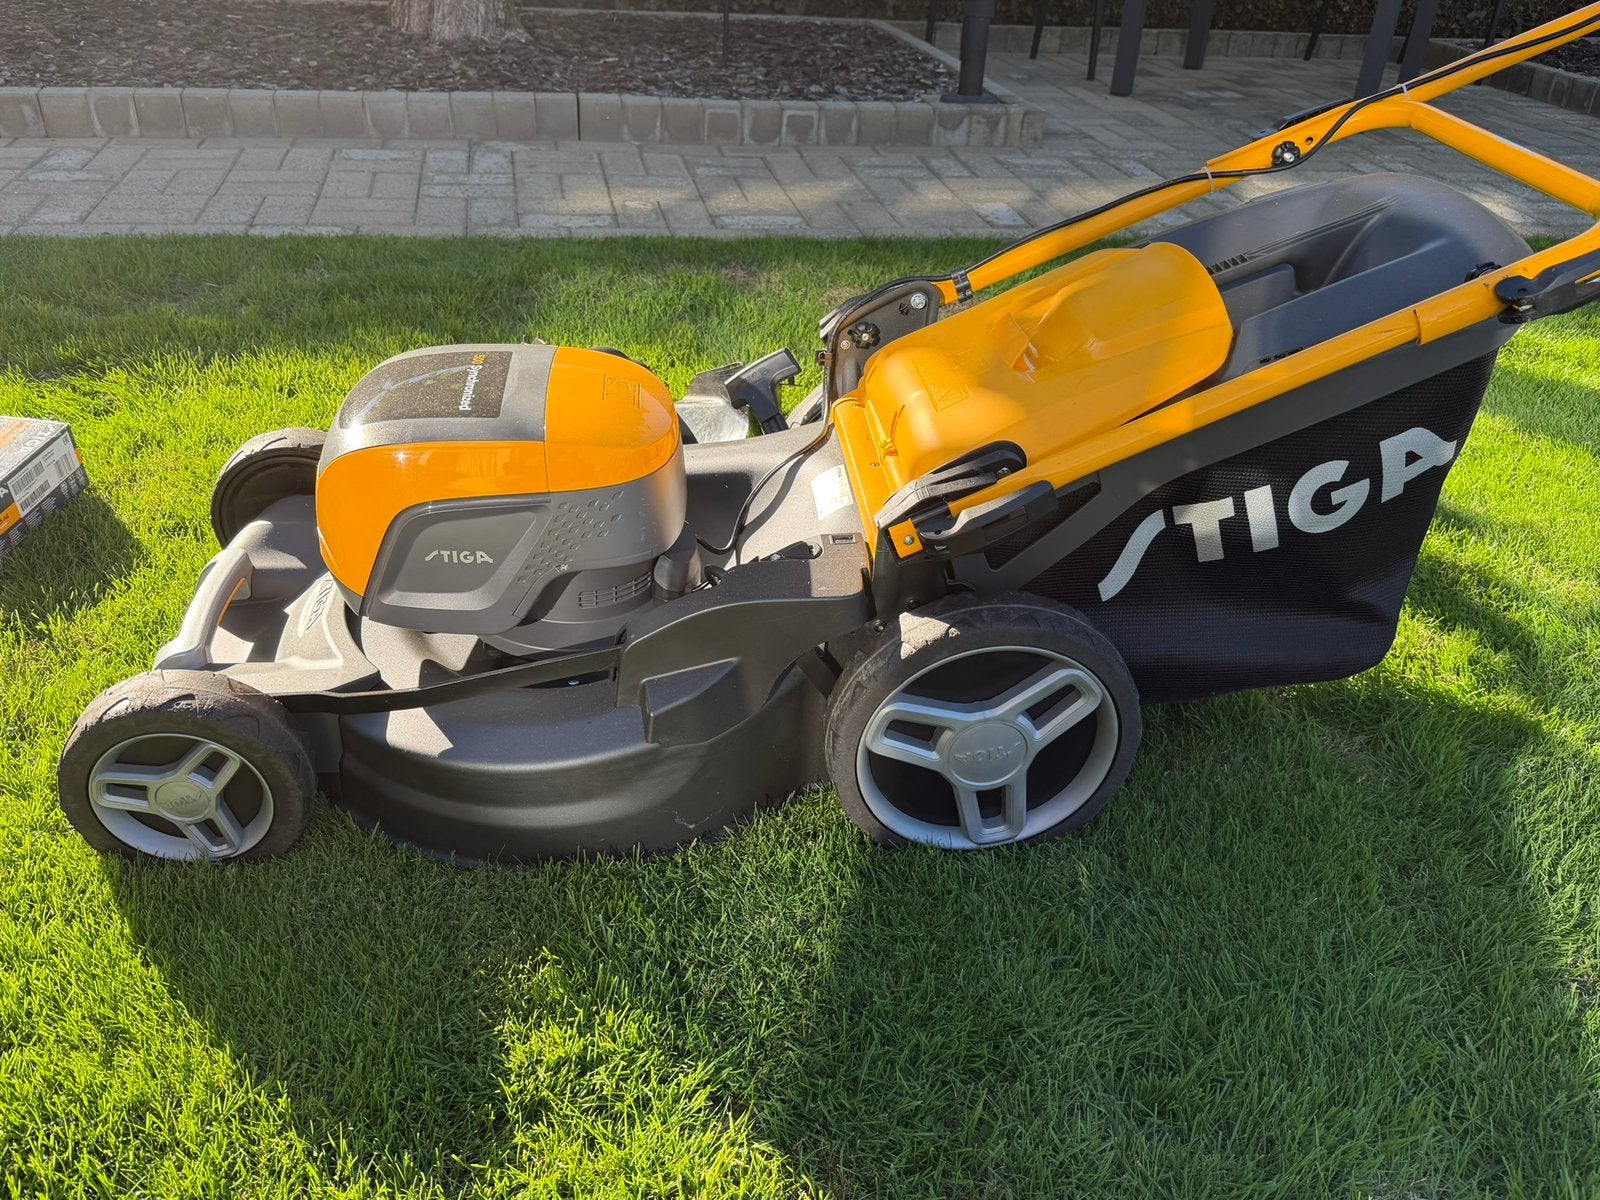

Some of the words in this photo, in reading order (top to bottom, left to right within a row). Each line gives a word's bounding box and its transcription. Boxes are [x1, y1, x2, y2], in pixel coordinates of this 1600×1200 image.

[459, 365, 483, 411] Synchronized
[1098, 427, 1457, 602] STIGA
[425, 549, 494, 564] STIGA
